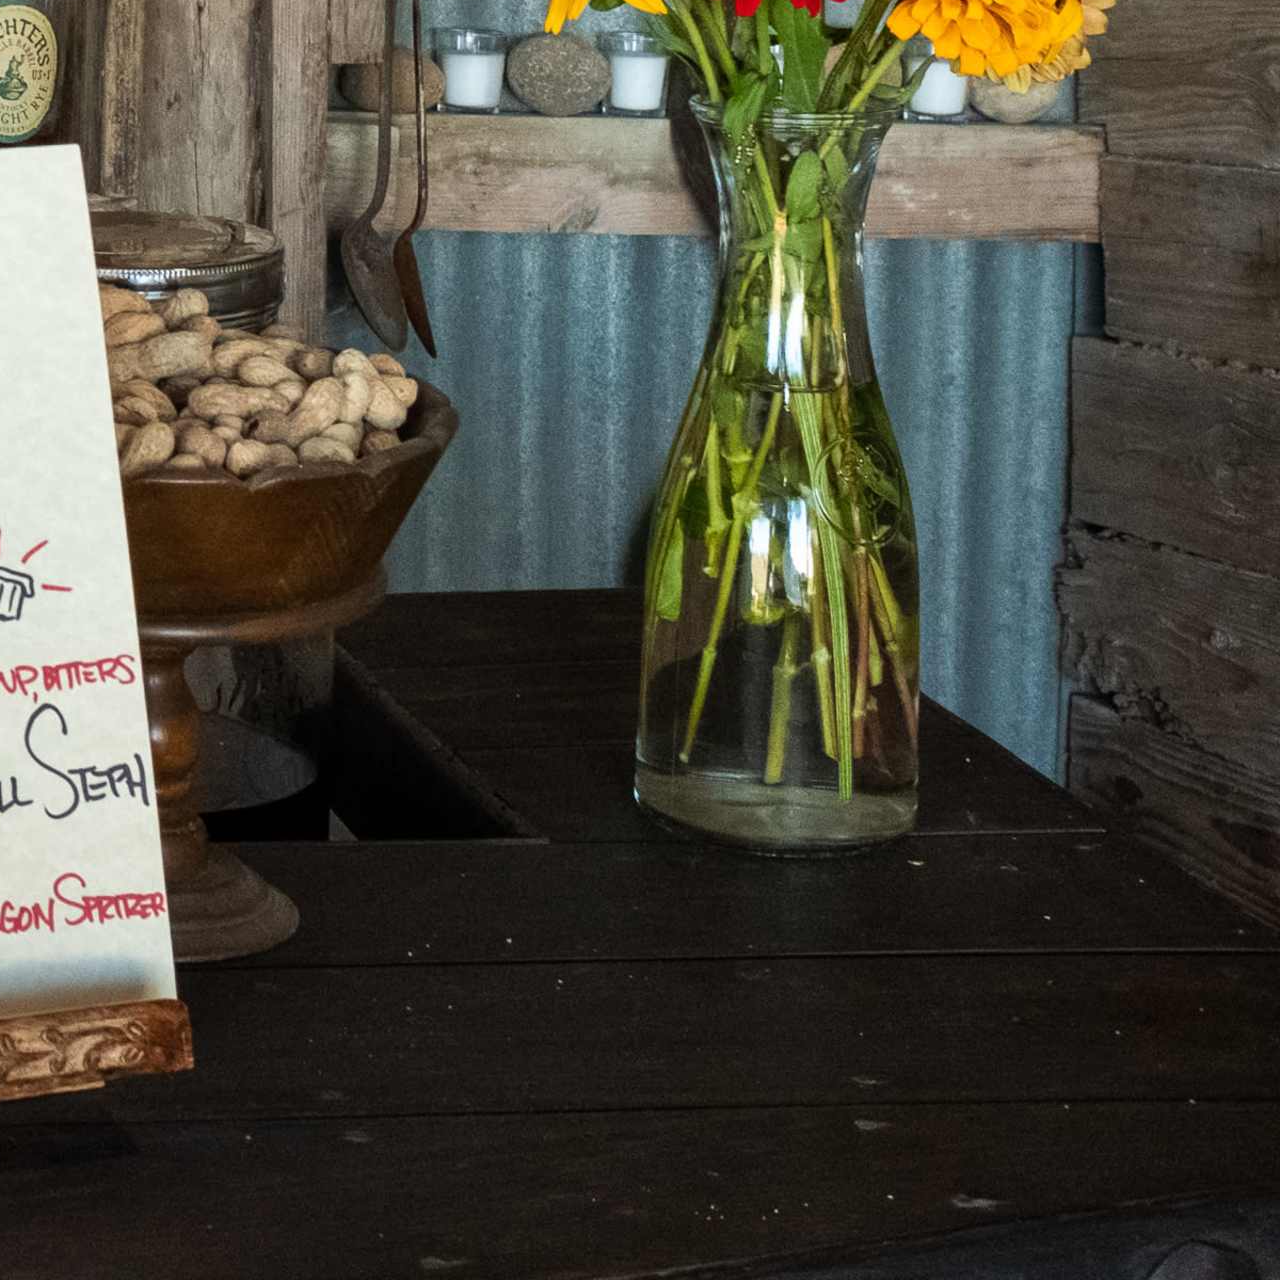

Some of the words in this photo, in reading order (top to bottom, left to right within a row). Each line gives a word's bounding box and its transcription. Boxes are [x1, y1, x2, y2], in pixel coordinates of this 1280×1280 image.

[30, 86, 49, 111] RYE
[42, 654, 136, 691] BITTERS
[24, 702, 151, 821] STEPH
